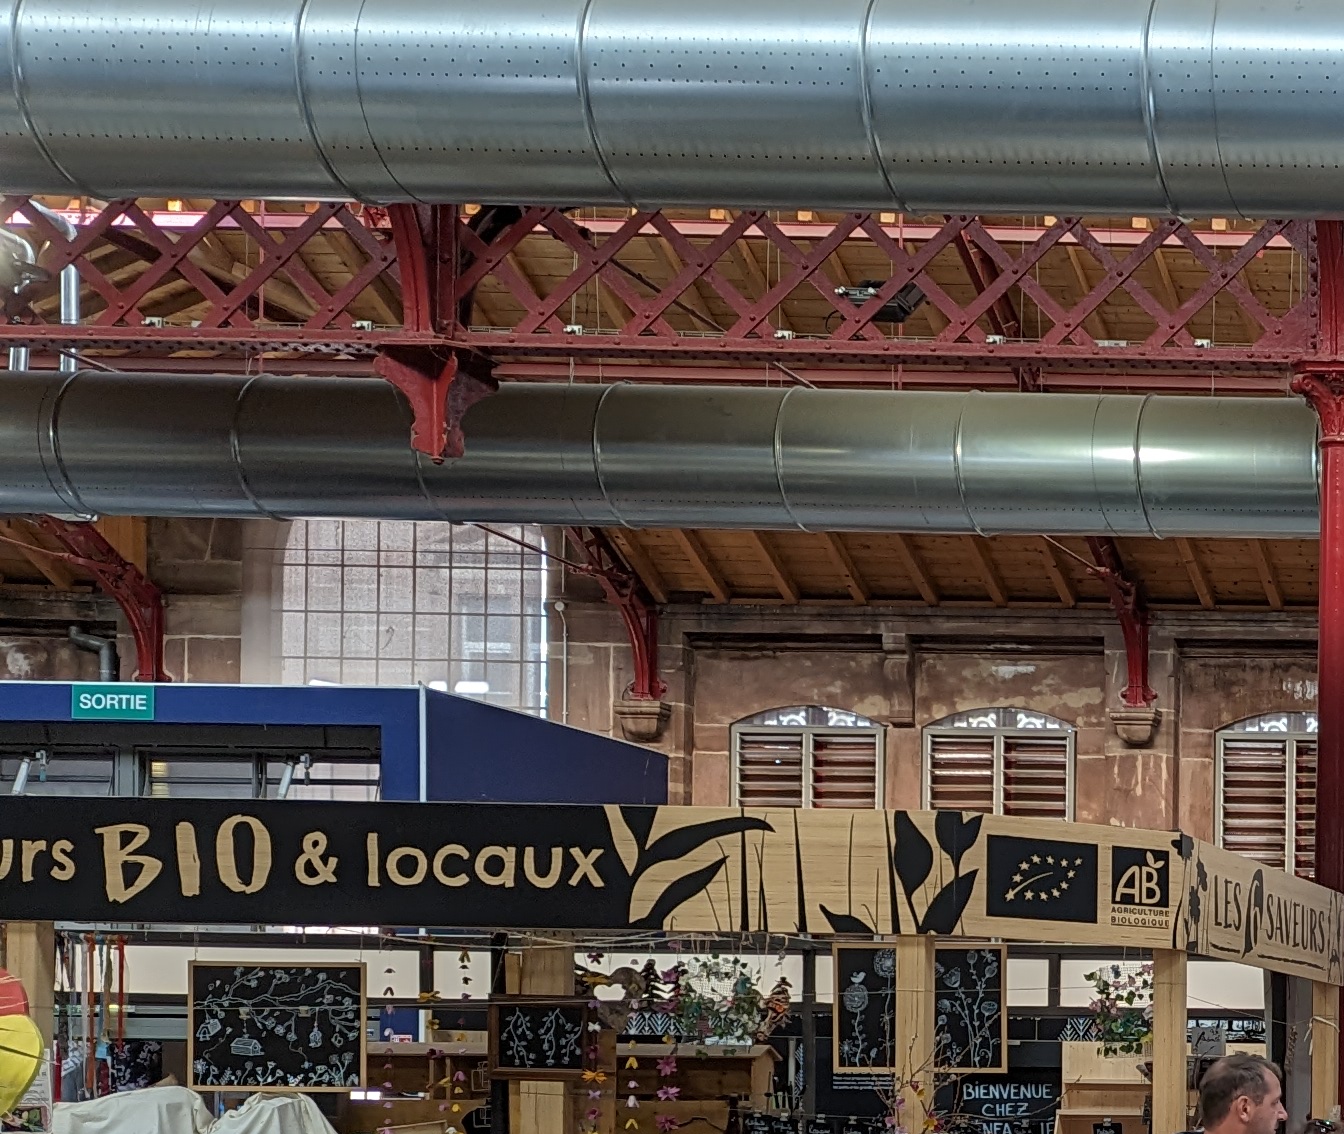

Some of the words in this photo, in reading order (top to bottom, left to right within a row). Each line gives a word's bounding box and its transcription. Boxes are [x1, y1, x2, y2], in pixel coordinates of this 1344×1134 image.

[79, 694, 147, 710] SORTIE
[94, 814, 272, 904] BIO
[295, 831, 338, 886] &
[367, 832, 604, 888] locaux
[1115, 865, 1161, 904] AB
[1111, 906, 1169, 918] AGRICULTURE
[1214, 875, 1242, 931] LES
[1266, 893, 1325, 954] SAVEURS
[1111, 916, 1169, 927] BIOLOGIQUE
[982, 1102, 1031, 1116] CHEZ
